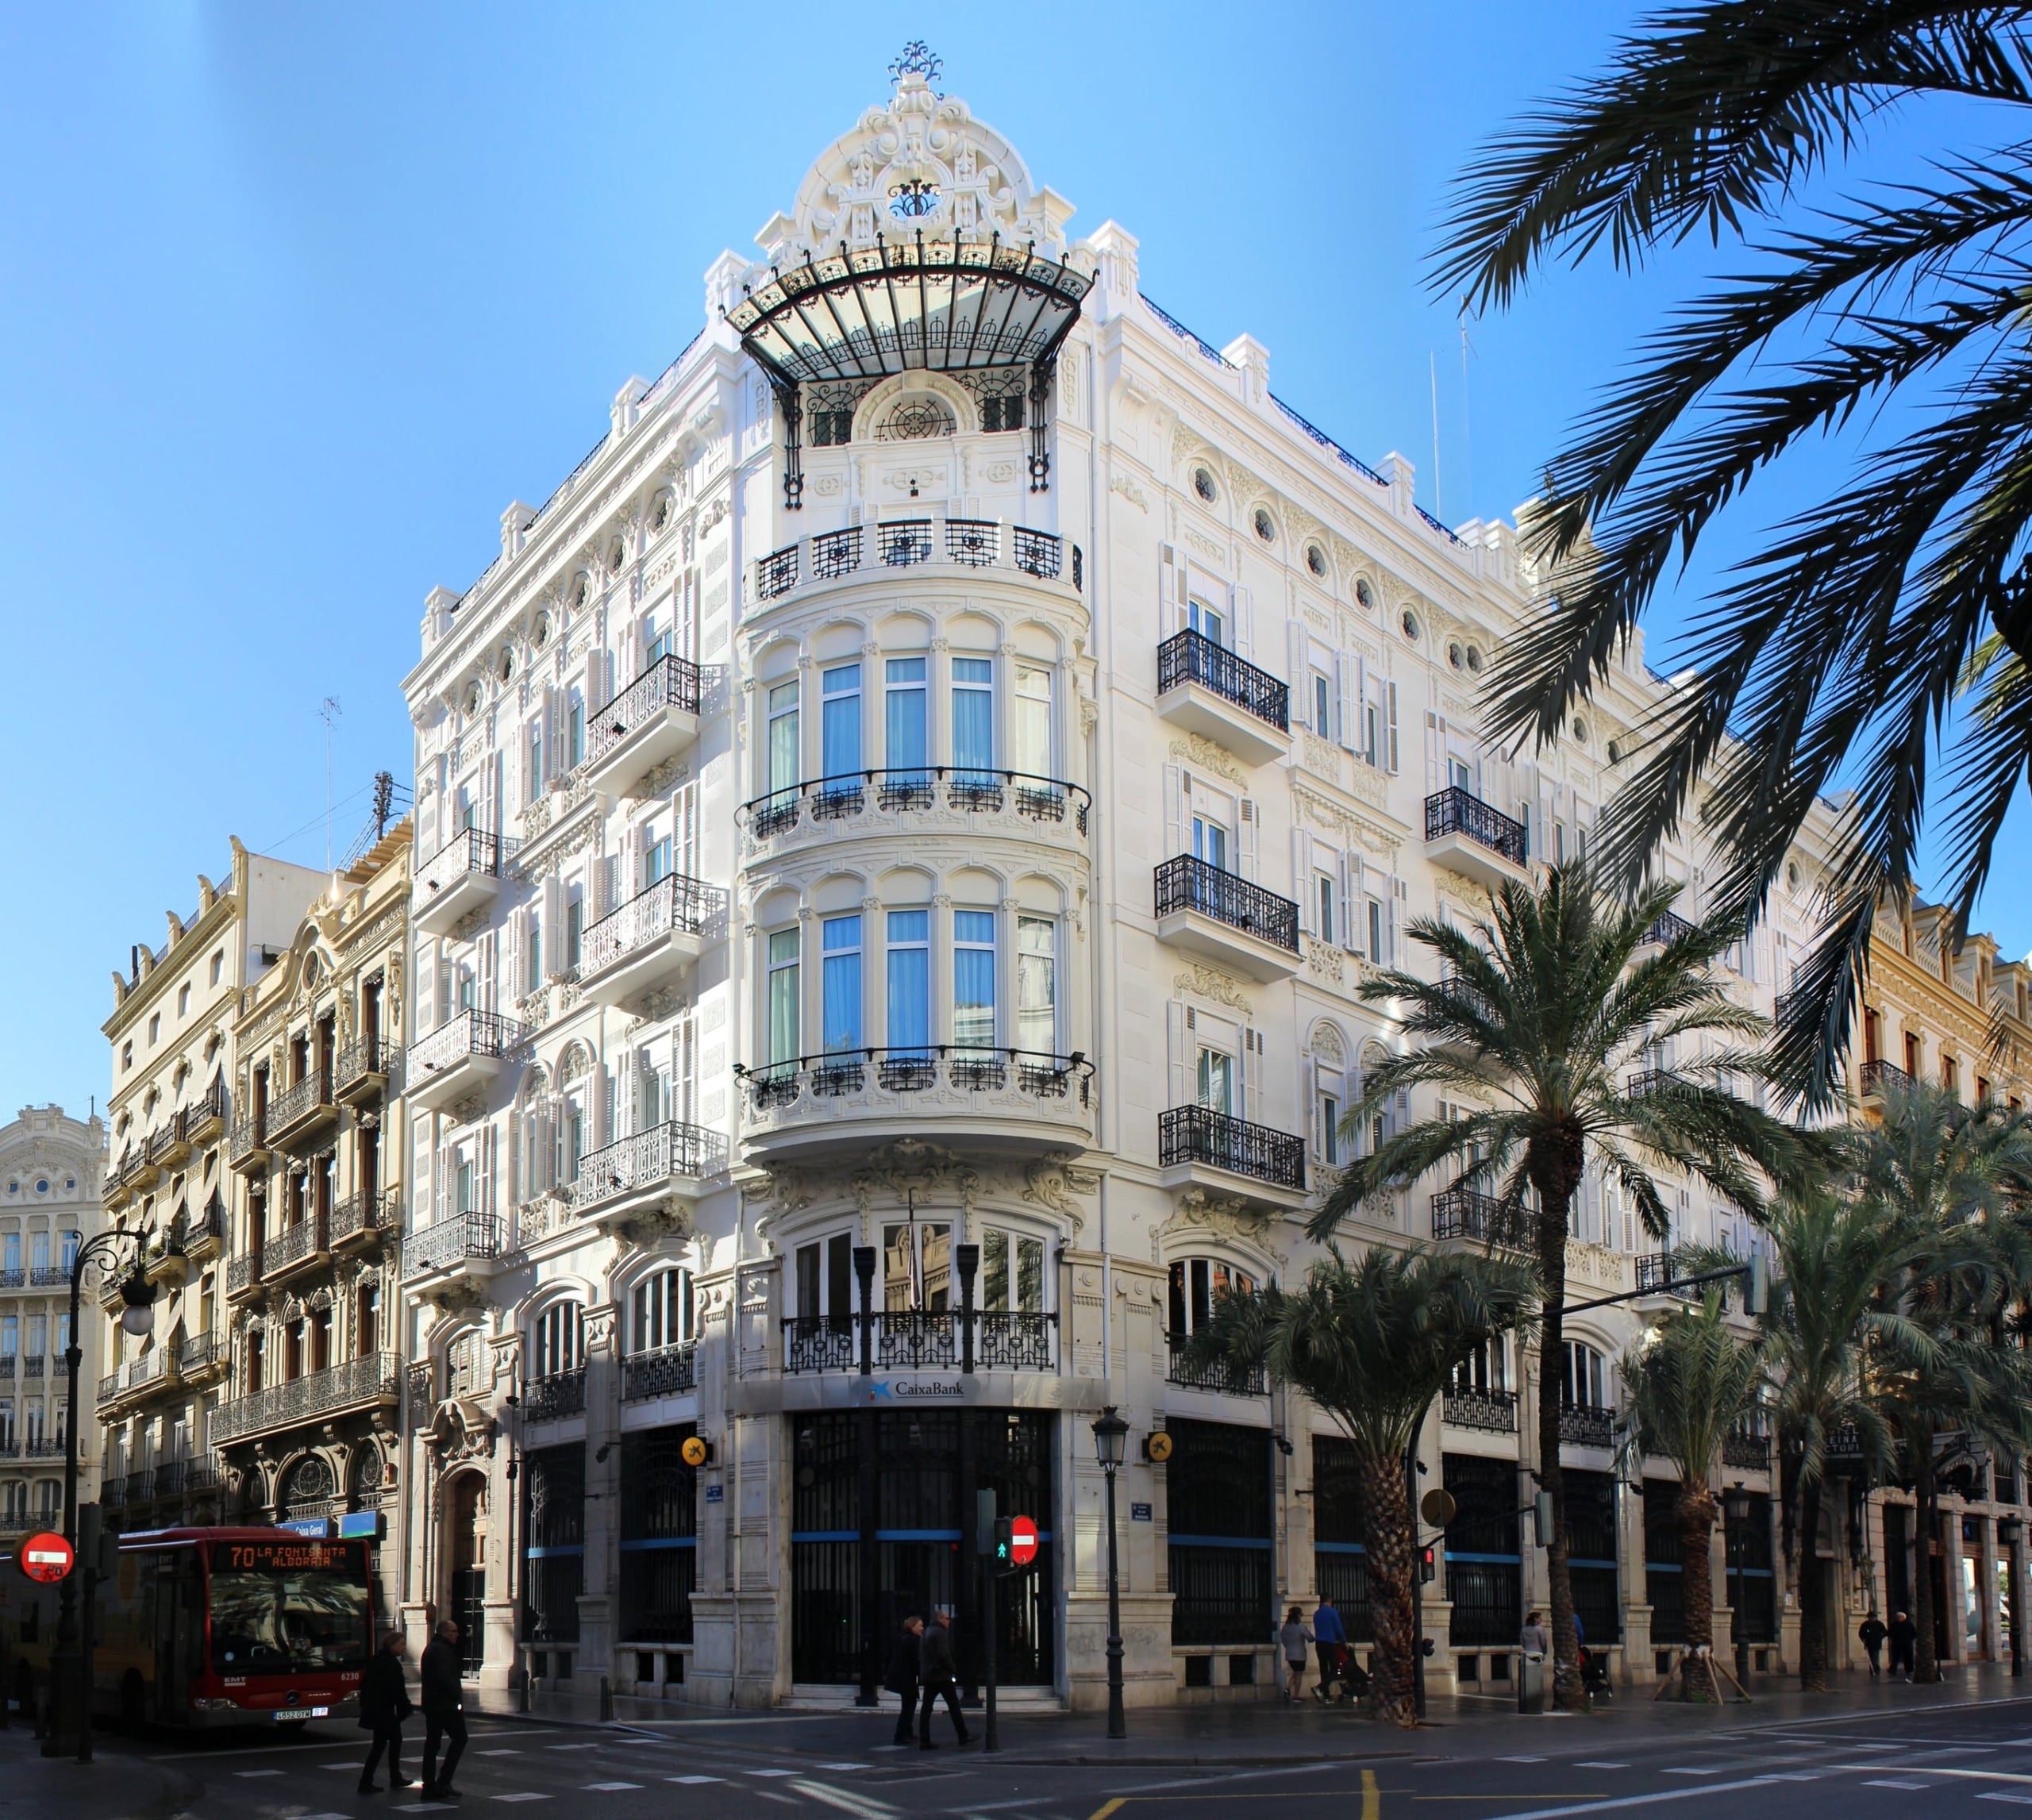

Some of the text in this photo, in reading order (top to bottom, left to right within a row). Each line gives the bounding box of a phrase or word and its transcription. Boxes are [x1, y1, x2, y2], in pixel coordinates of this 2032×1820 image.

[895, 1382, 964, 1395] CaixaBank
[310, 1523, 324, 1536] Geral
[231, 1547, 345, 1567] 70 LA FONTSANTA
